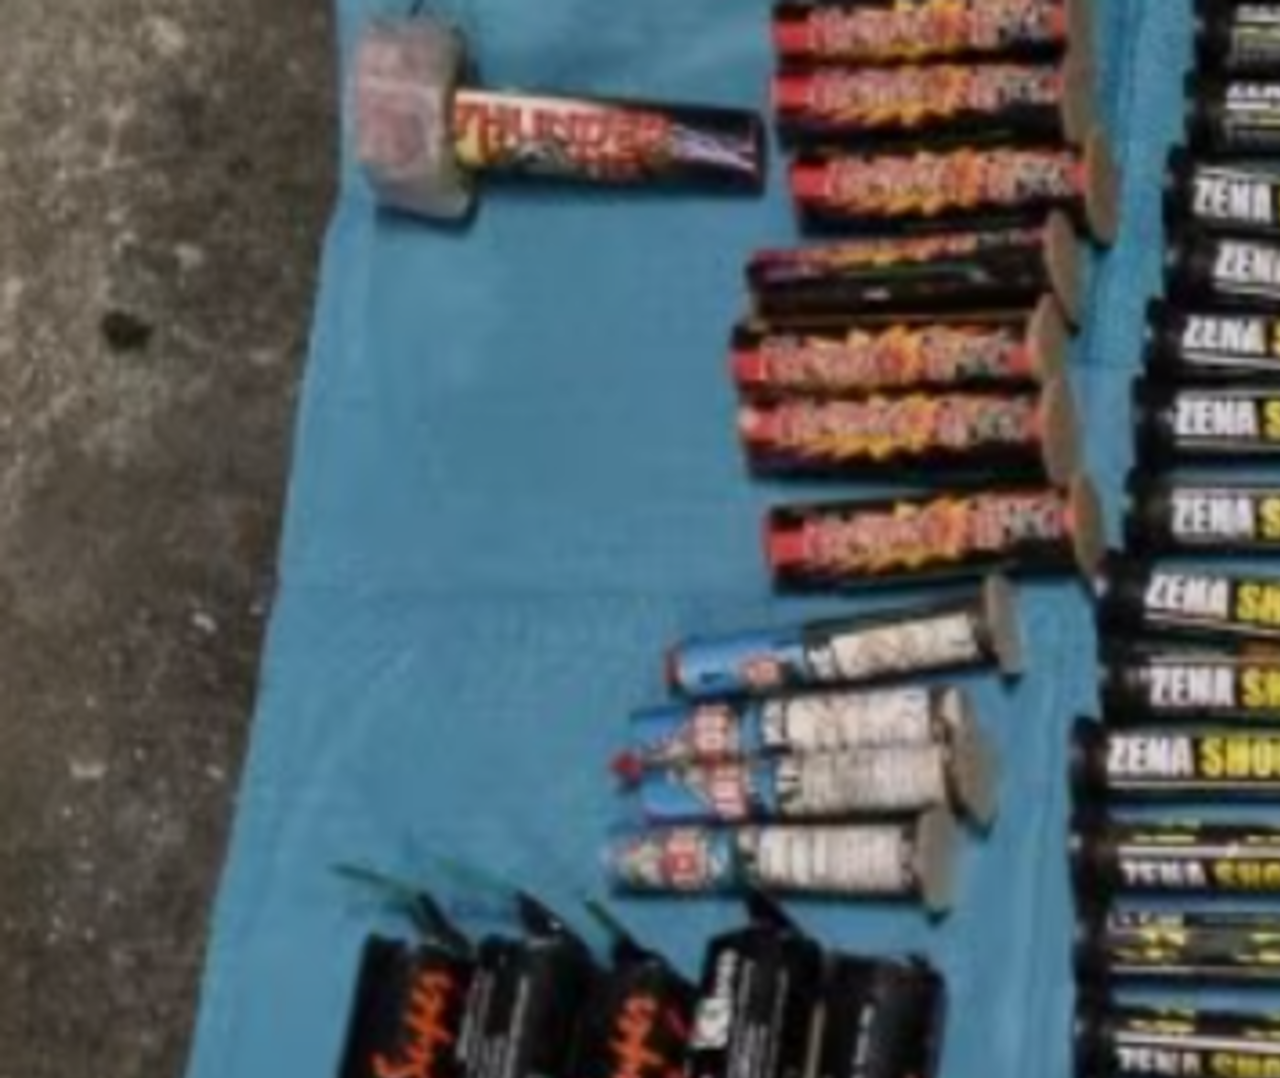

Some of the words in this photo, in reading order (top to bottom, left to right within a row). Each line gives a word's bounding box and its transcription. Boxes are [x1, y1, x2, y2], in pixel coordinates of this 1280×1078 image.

[1195, 177, 1272, 223] ZENA
[1181, 316, 1266, 354] ZENA
[1173, 395, 1259, 437] ZENA
[1172, 491, 1254, 535] ZENA
[1145, 574, 1229, 617] ZENA
[1150, 666, 1233, 706] ZENA
[1107, 735, 1193, 776] ZENA
